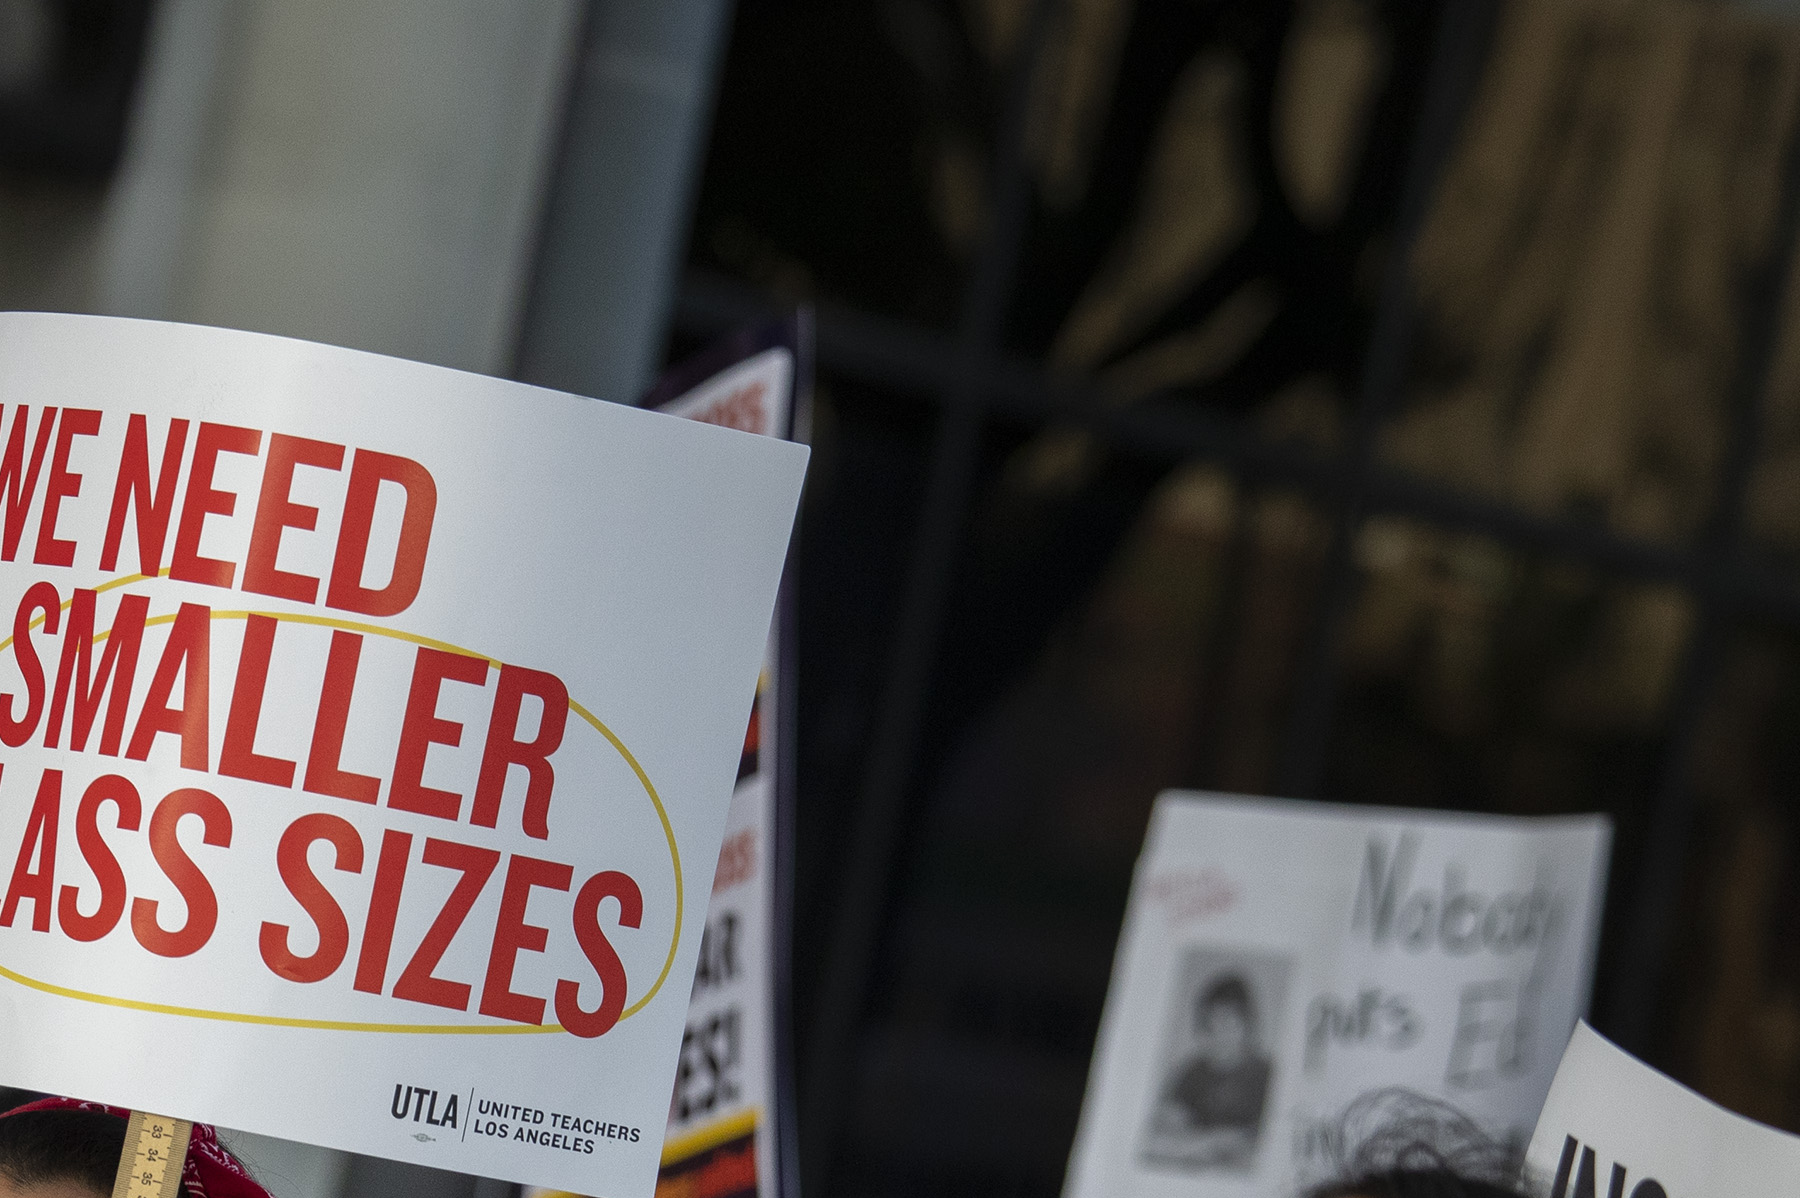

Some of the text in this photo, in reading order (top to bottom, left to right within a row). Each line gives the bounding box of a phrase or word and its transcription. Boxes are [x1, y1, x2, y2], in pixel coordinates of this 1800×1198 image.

[98, 413, 438, 618] NEED
[258, 812, 643, 1039] SIZES
[390, 1083, 459, 1130] UTLA
[477, 1098, 642, 1143] UNITED TEACHERS
[151, 1124, 164, 1139] 33
[473, 1118, 596, 1155] LOS ANGELES
[146, 1148, 159, 1162] 34
[141, 1171, 153, 1186] 35
